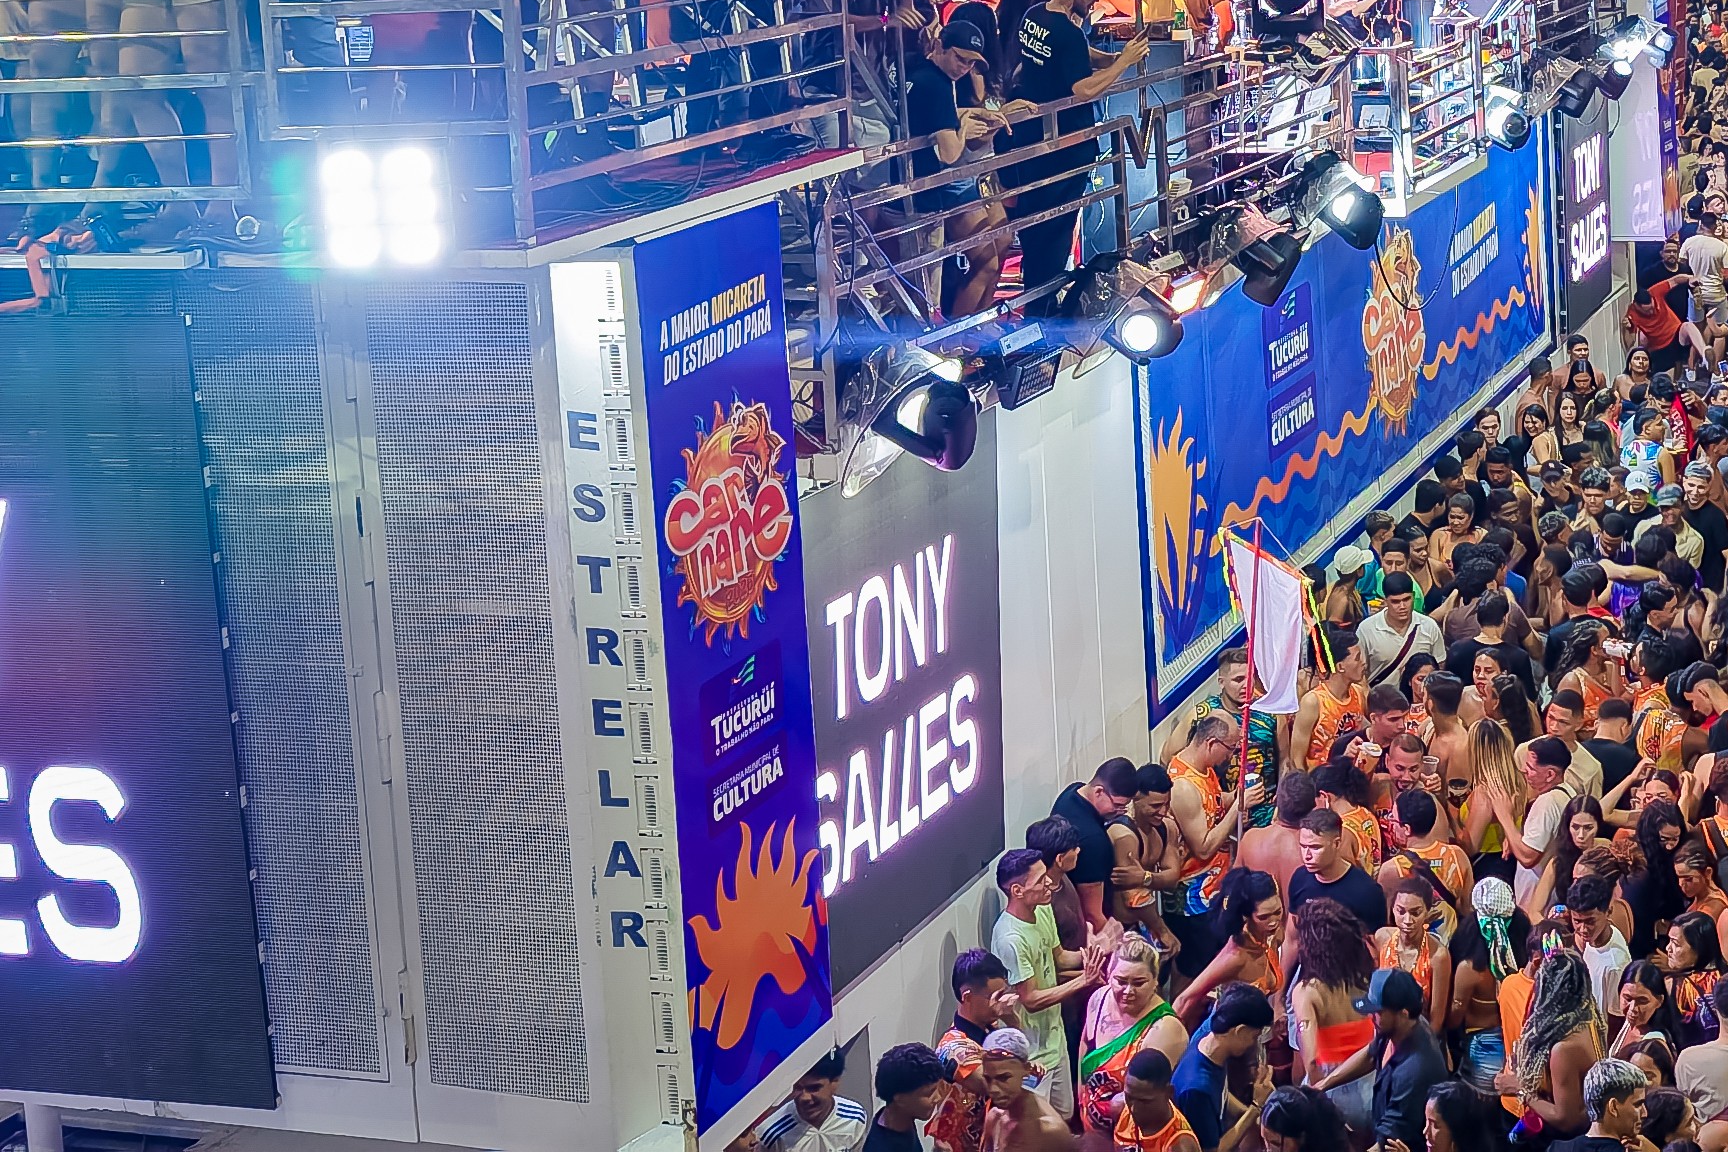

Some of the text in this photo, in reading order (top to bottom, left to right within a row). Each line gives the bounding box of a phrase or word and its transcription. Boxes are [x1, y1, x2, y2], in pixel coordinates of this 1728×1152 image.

[1018, 30, 1052, 58] SALLES
[1023, 18, 1051, 41] TONY
[1573, 132, 1602, 204] TONY
[1570, 201, 1607, 283] SALLES
[659, 273, 766, 352] A MAIOR MICARETA
[663, 299, 772, 386] DO ESTADO DO PARÁ
[1271, 397, 1315, 447] CULTURA
[825, 533, 952, 721] TONY
[566, 410, 649, 949] ESTRELAR
[710, 681, 776, 746] TUCURUÍ
[720, 728, 749, 754] TRABALHO
[713, 756, 784, 822] CULTURA
[816, 673, 978, 900] SALLES
